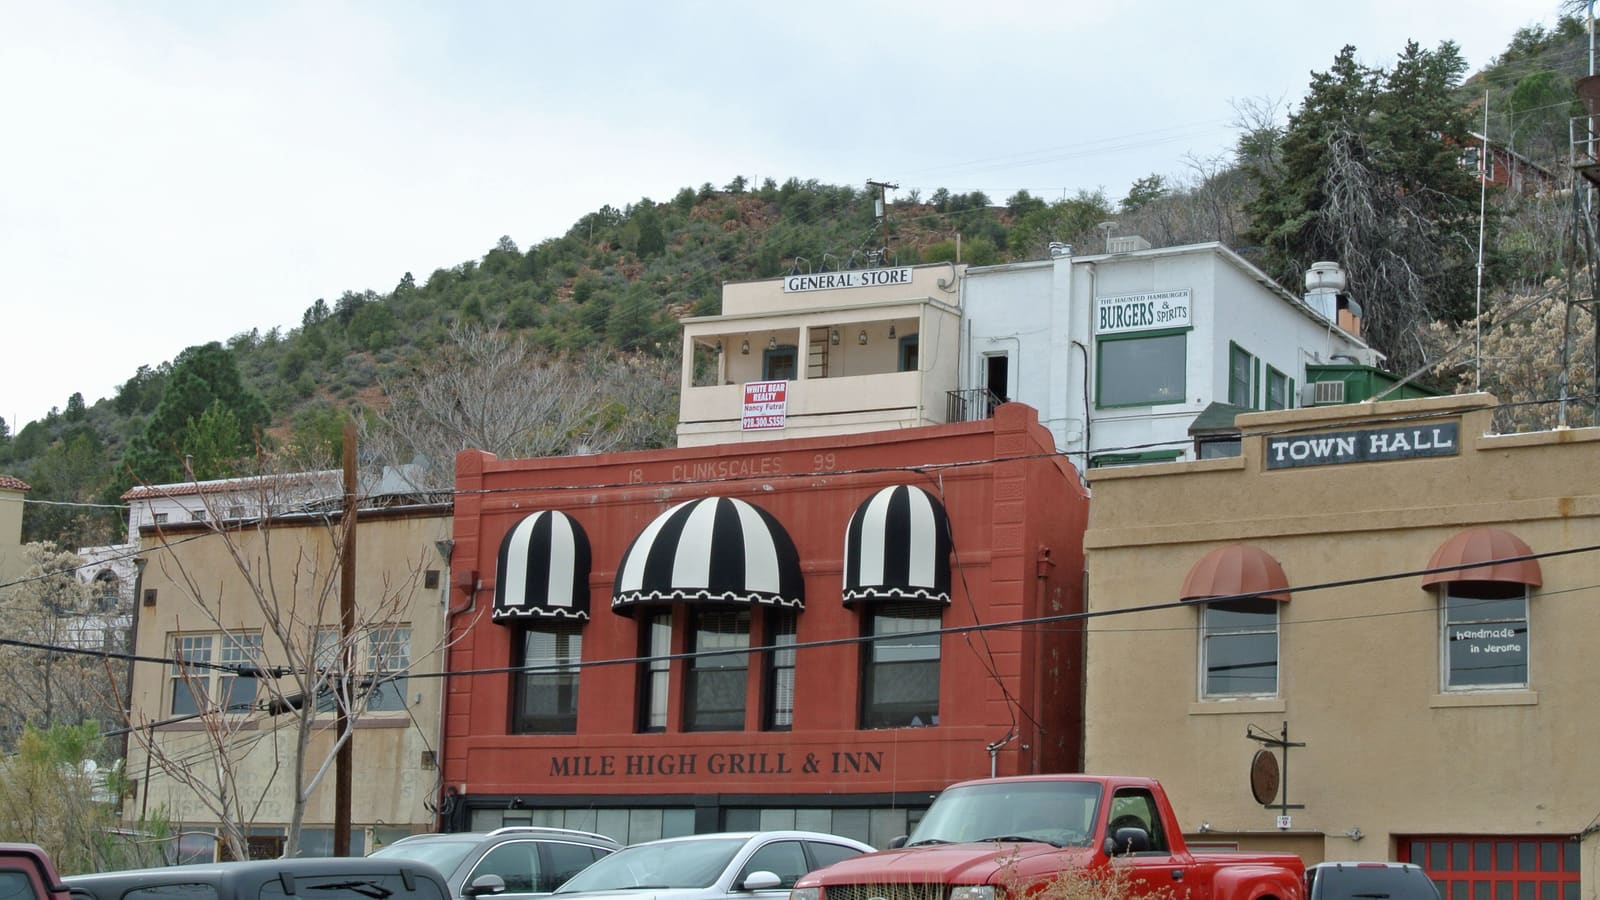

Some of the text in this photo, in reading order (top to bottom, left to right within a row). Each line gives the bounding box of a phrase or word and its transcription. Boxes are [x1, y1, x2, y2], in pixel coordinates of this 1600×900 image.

[789, 269, 908, 291] GENERAL STORE
[1115, 295, 1145, 303] HAUNTED
[1147, 291, 1188, 300] HAMBURGER
[1100, 301, 1187, 330] BURGERS & SPIRITS
[747, 383, 785, 393] WHITE BEAR
[753, 392, 776, 401] REALTY
[745, 404, 762, 412] Nancy
[1272, 429, 1452, 461] TOWN HALL
[629, 453, 835, 484] 18 CLINKSCALES 99
[1456, 628, 1515, 640] handmade
[1470, 644, 1521, 653] in Jerome
[549, 752, 884, 776] MILE HIGH GRILL & INN
